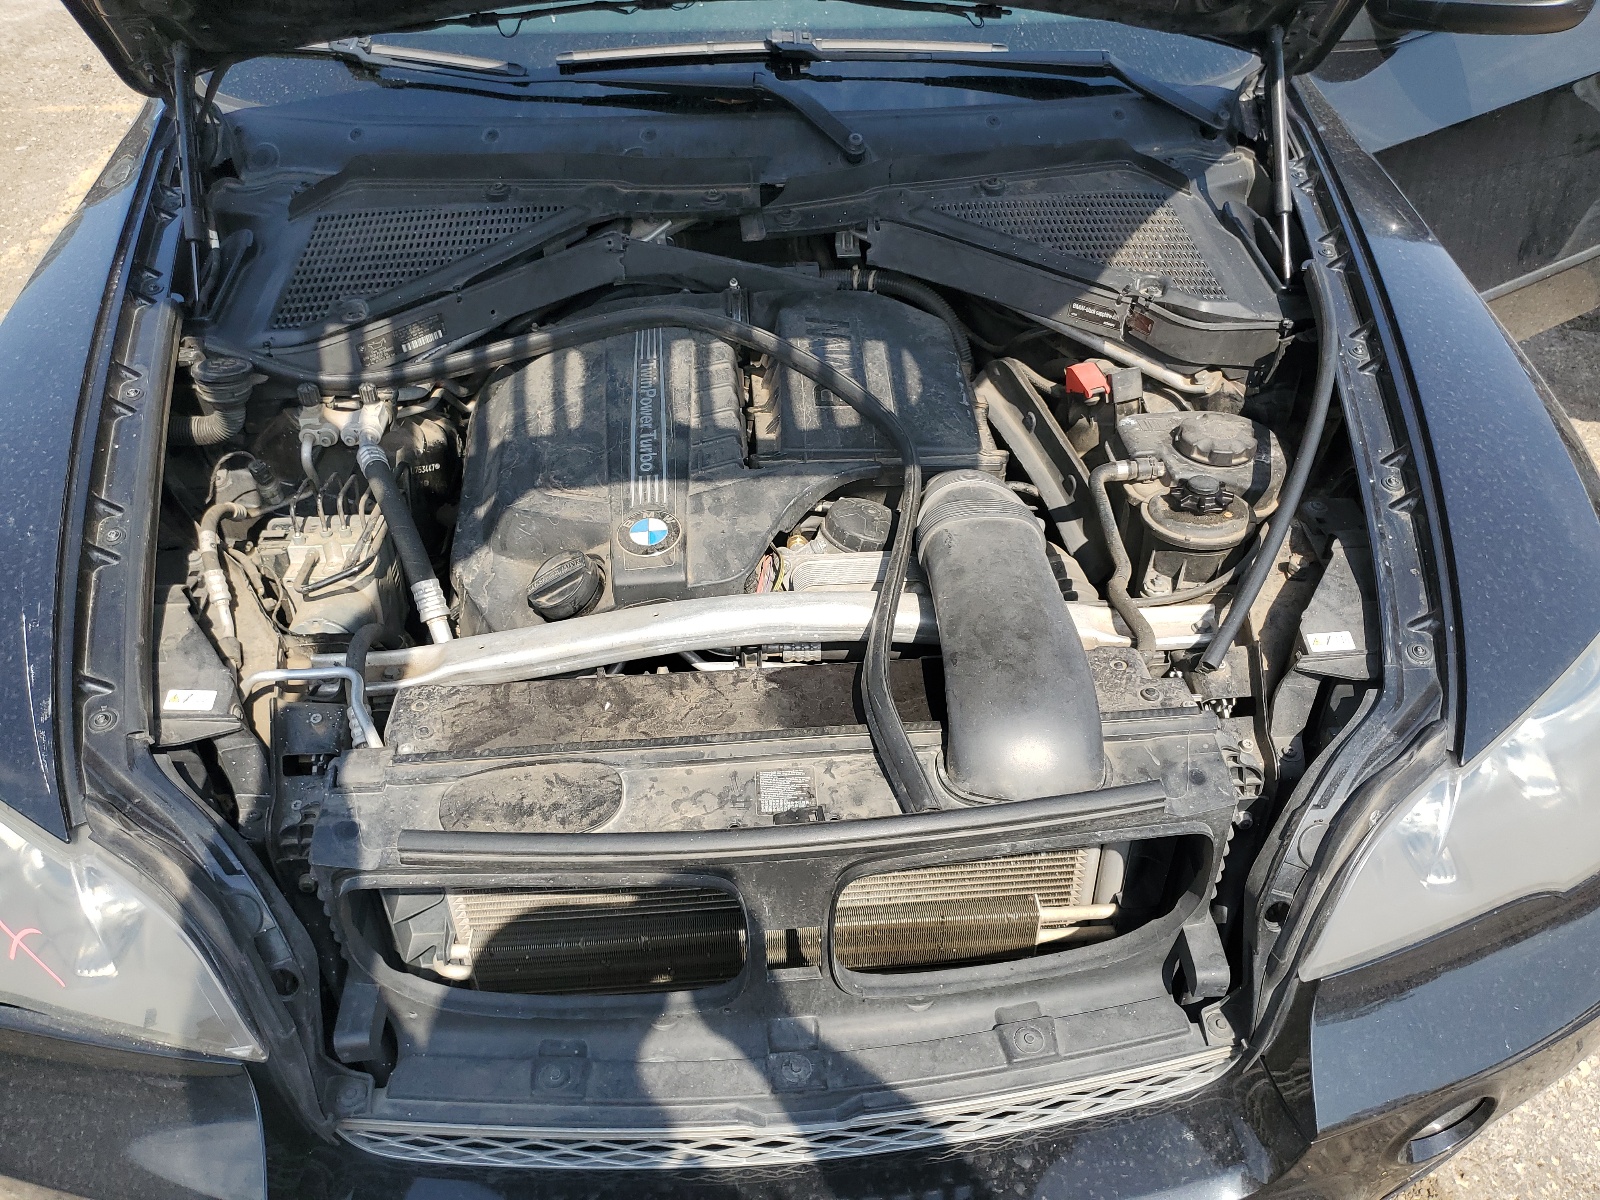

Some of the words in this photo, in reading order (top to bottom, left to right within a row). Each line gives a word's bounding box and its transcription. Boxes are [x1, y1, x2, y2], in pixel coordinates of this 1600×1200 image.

[639, 359, 657, 428] TwinPower
[639, 429, 657, 472] Turbo
[623, 511, 676, 528] BMW
